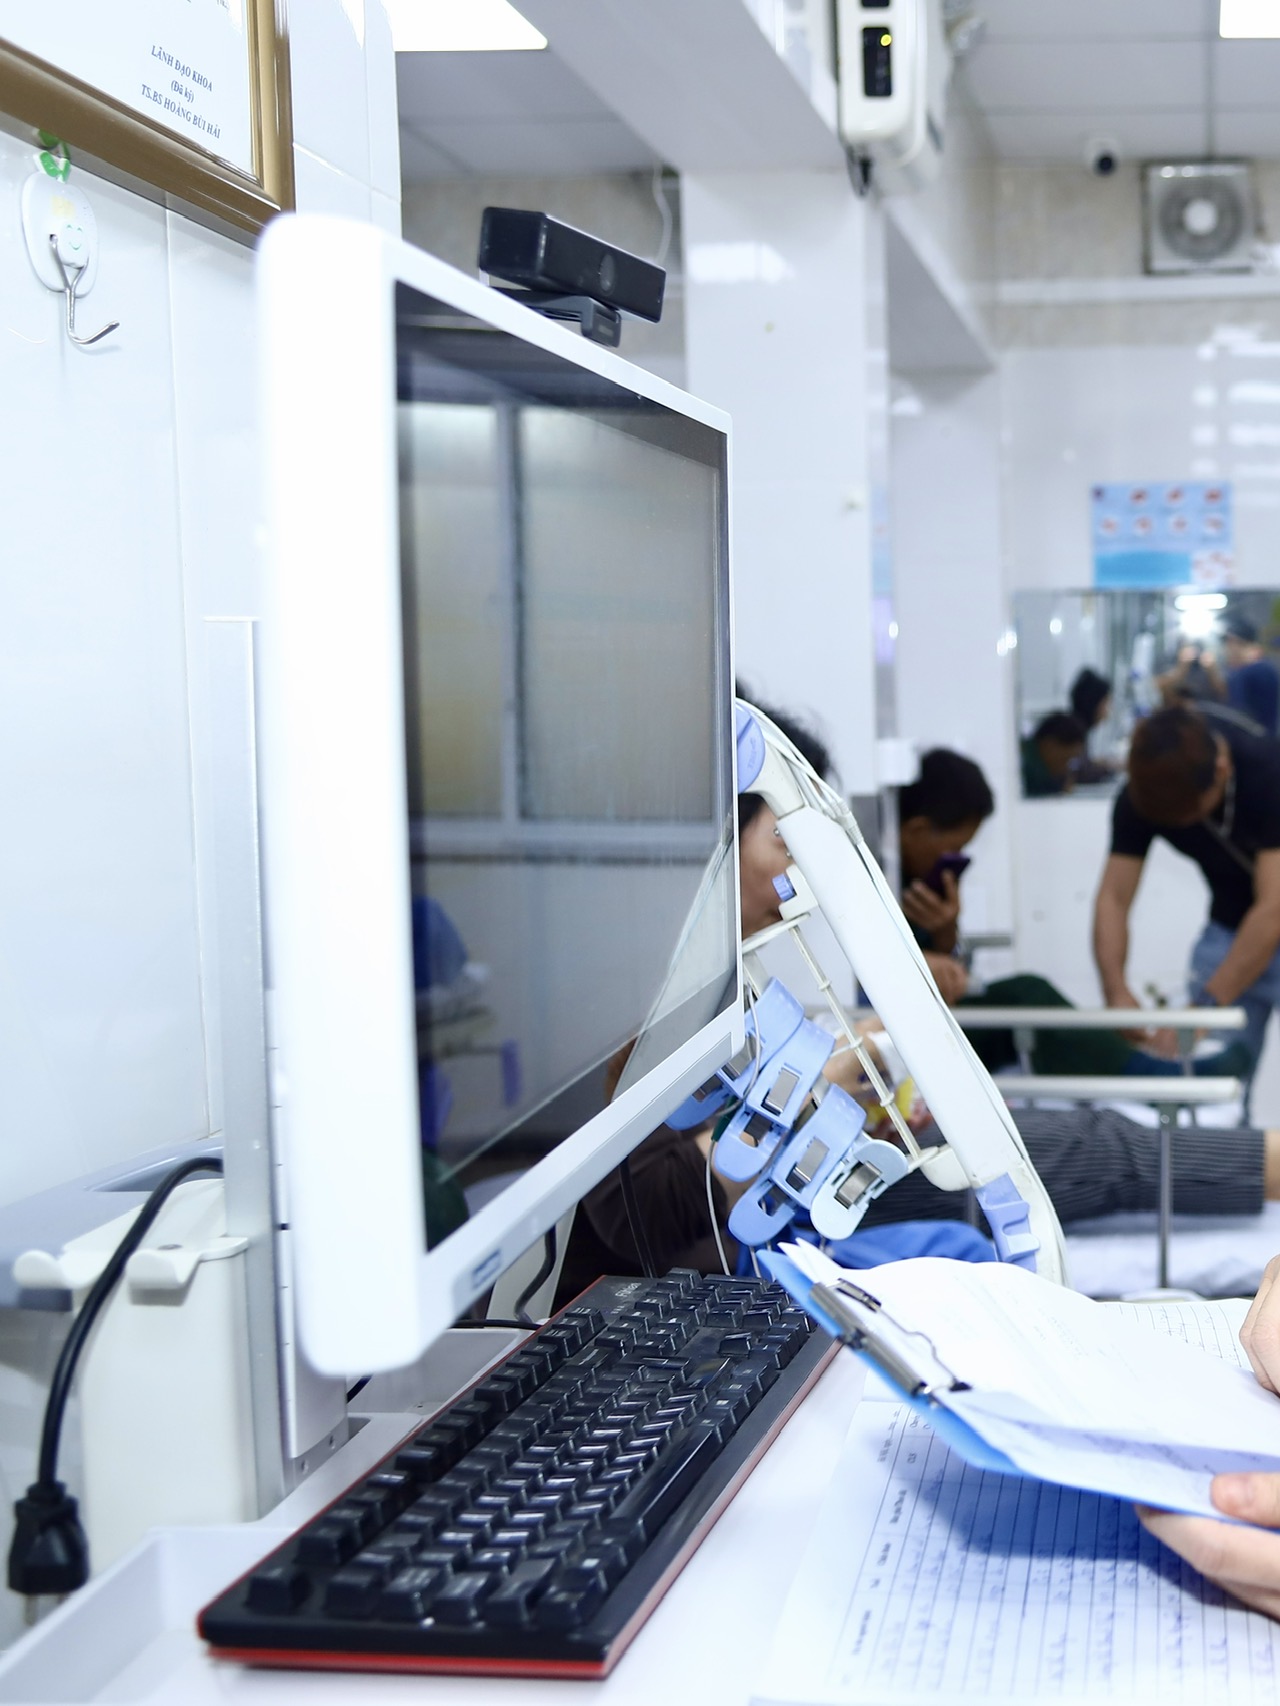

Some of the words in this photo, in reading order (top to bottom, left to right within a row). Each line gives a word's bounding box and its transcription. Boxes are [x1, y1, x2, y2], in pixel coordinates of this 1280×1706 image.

[174, 59, 191, 77] ĐẠO
[192, 70, 212, 92] KHOA
[141, 83, 163, 105] TS.BS
[163, 97, 192, 122] HOÀNG
